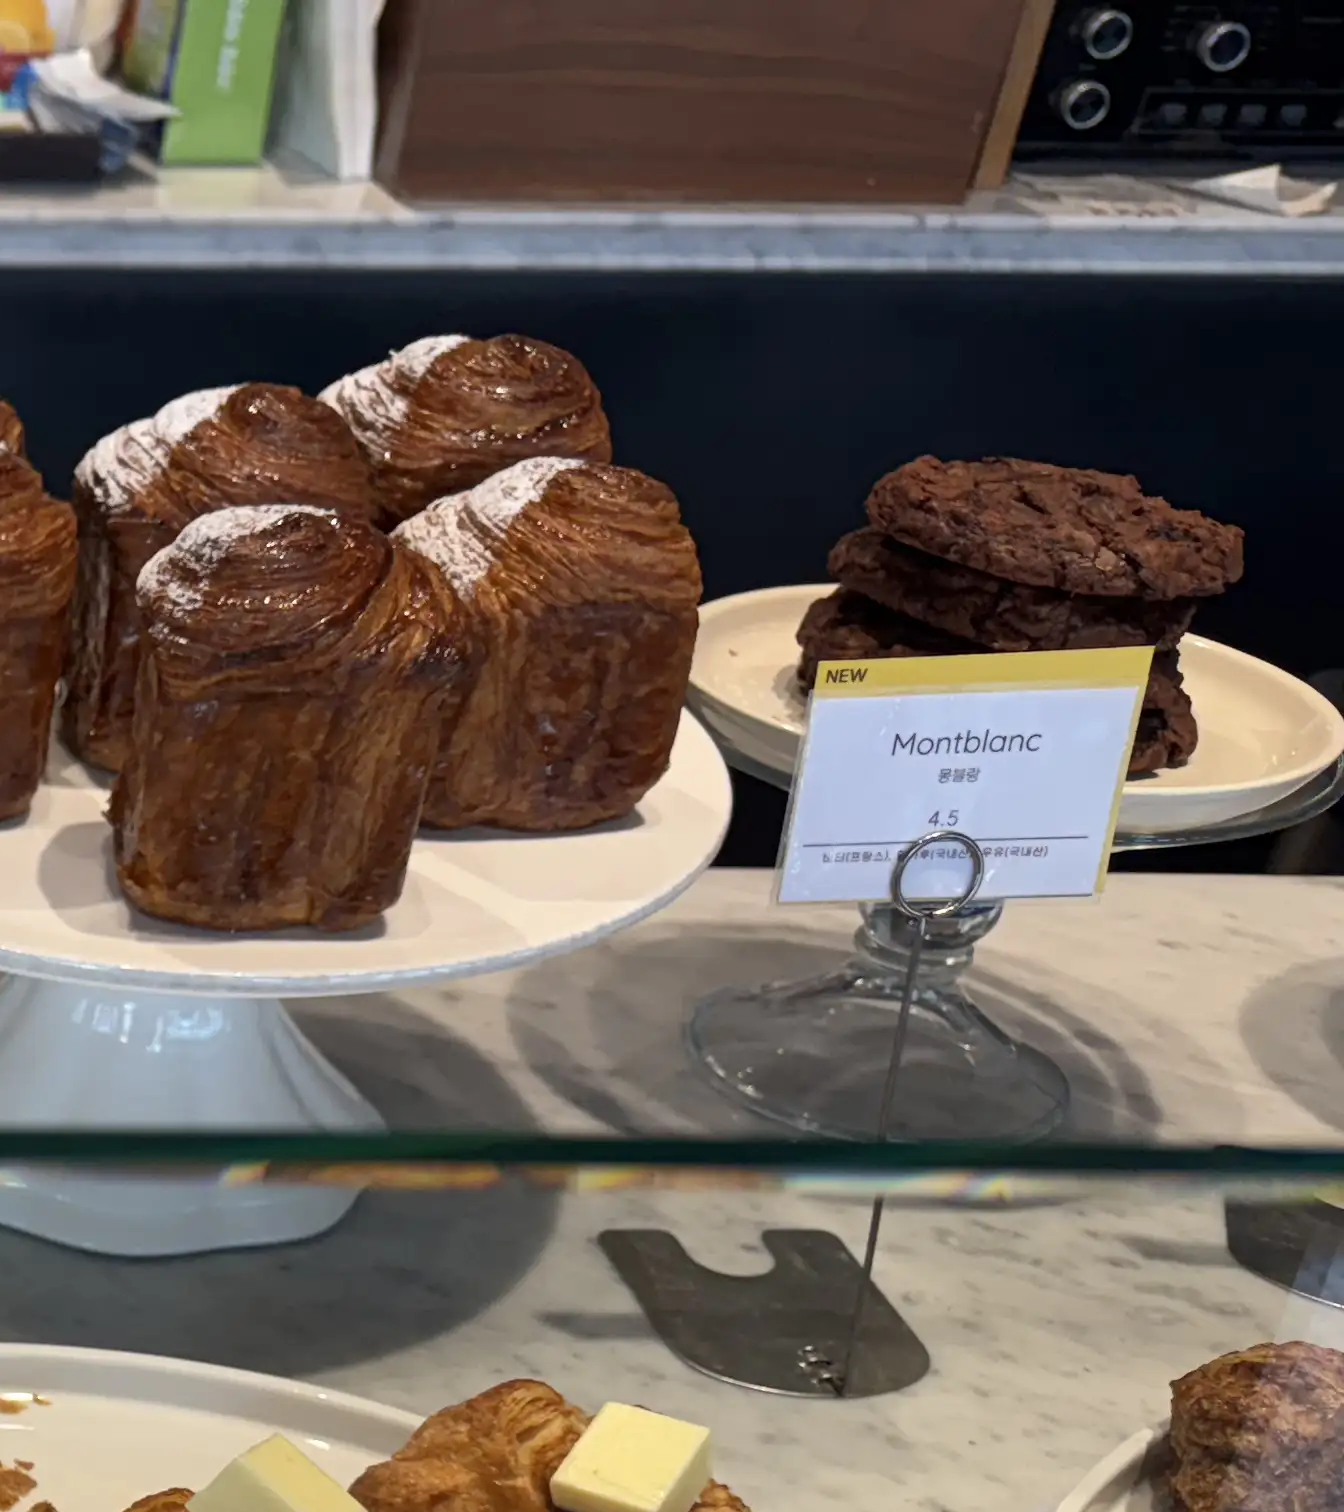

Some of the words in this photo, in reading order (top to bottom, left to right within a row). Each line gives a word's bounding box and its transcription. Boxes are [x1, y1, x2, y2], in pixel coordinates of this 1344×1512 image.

[825, 667, 869, 684] NEW
[891, 729, 1043, 757] Montblanc
[937, 767, 981, 784] 몽블랑
[928, 809, 960, 827] 4.5
